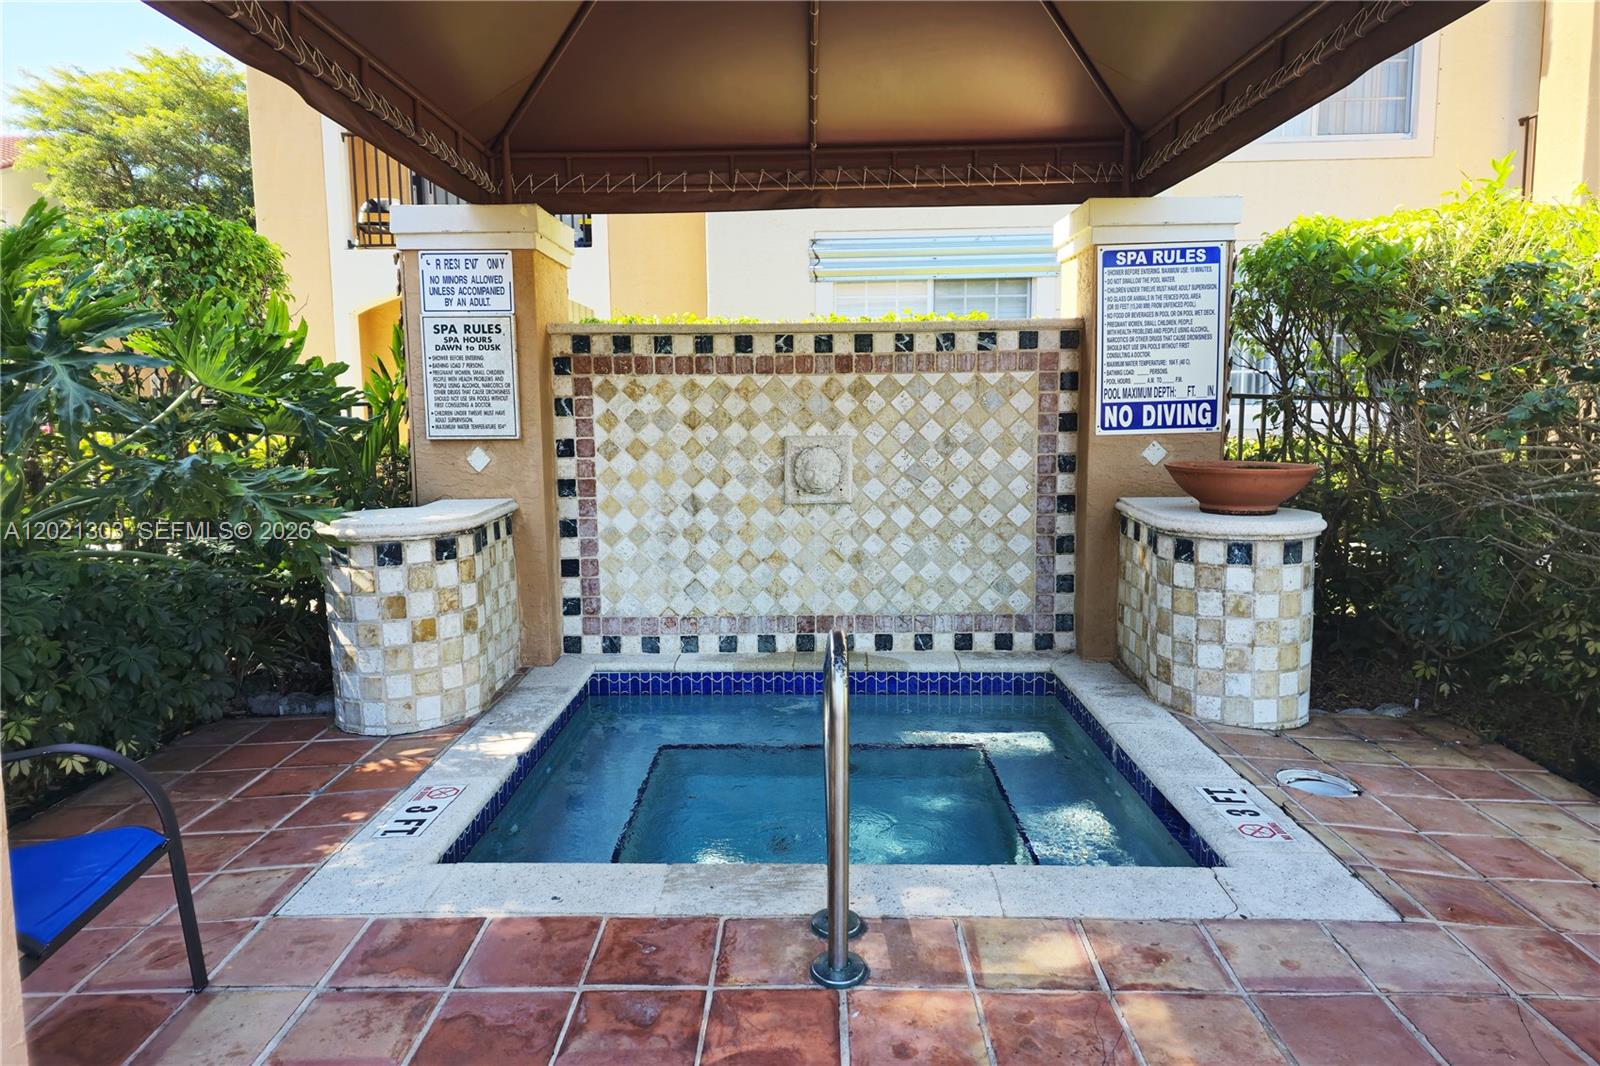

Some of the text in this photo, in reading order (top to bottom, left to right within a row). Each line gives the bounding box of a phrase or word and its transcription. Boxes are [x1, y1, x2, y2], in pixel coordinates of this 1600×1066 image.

[1116, 248, 1207, 265] SPA RULES
[430, 276, 503, 284] NO MINORS ALLOWED
[429, 287, 505, 296] UNLESS ACCOMPANIED
[445, 298, 453, 306] BY
[457, 298, 466, 306] AN
[433, 324, 502, 334] SPA RULES
[1104, 385, 1216, 400] POOL MAXIMUM DEPTH: FT. IN.
[1105, 402, 1212, 428] NO DIVING
[405, 805, 438, 813] 3
[1226, 809, 1260, 817] 3
